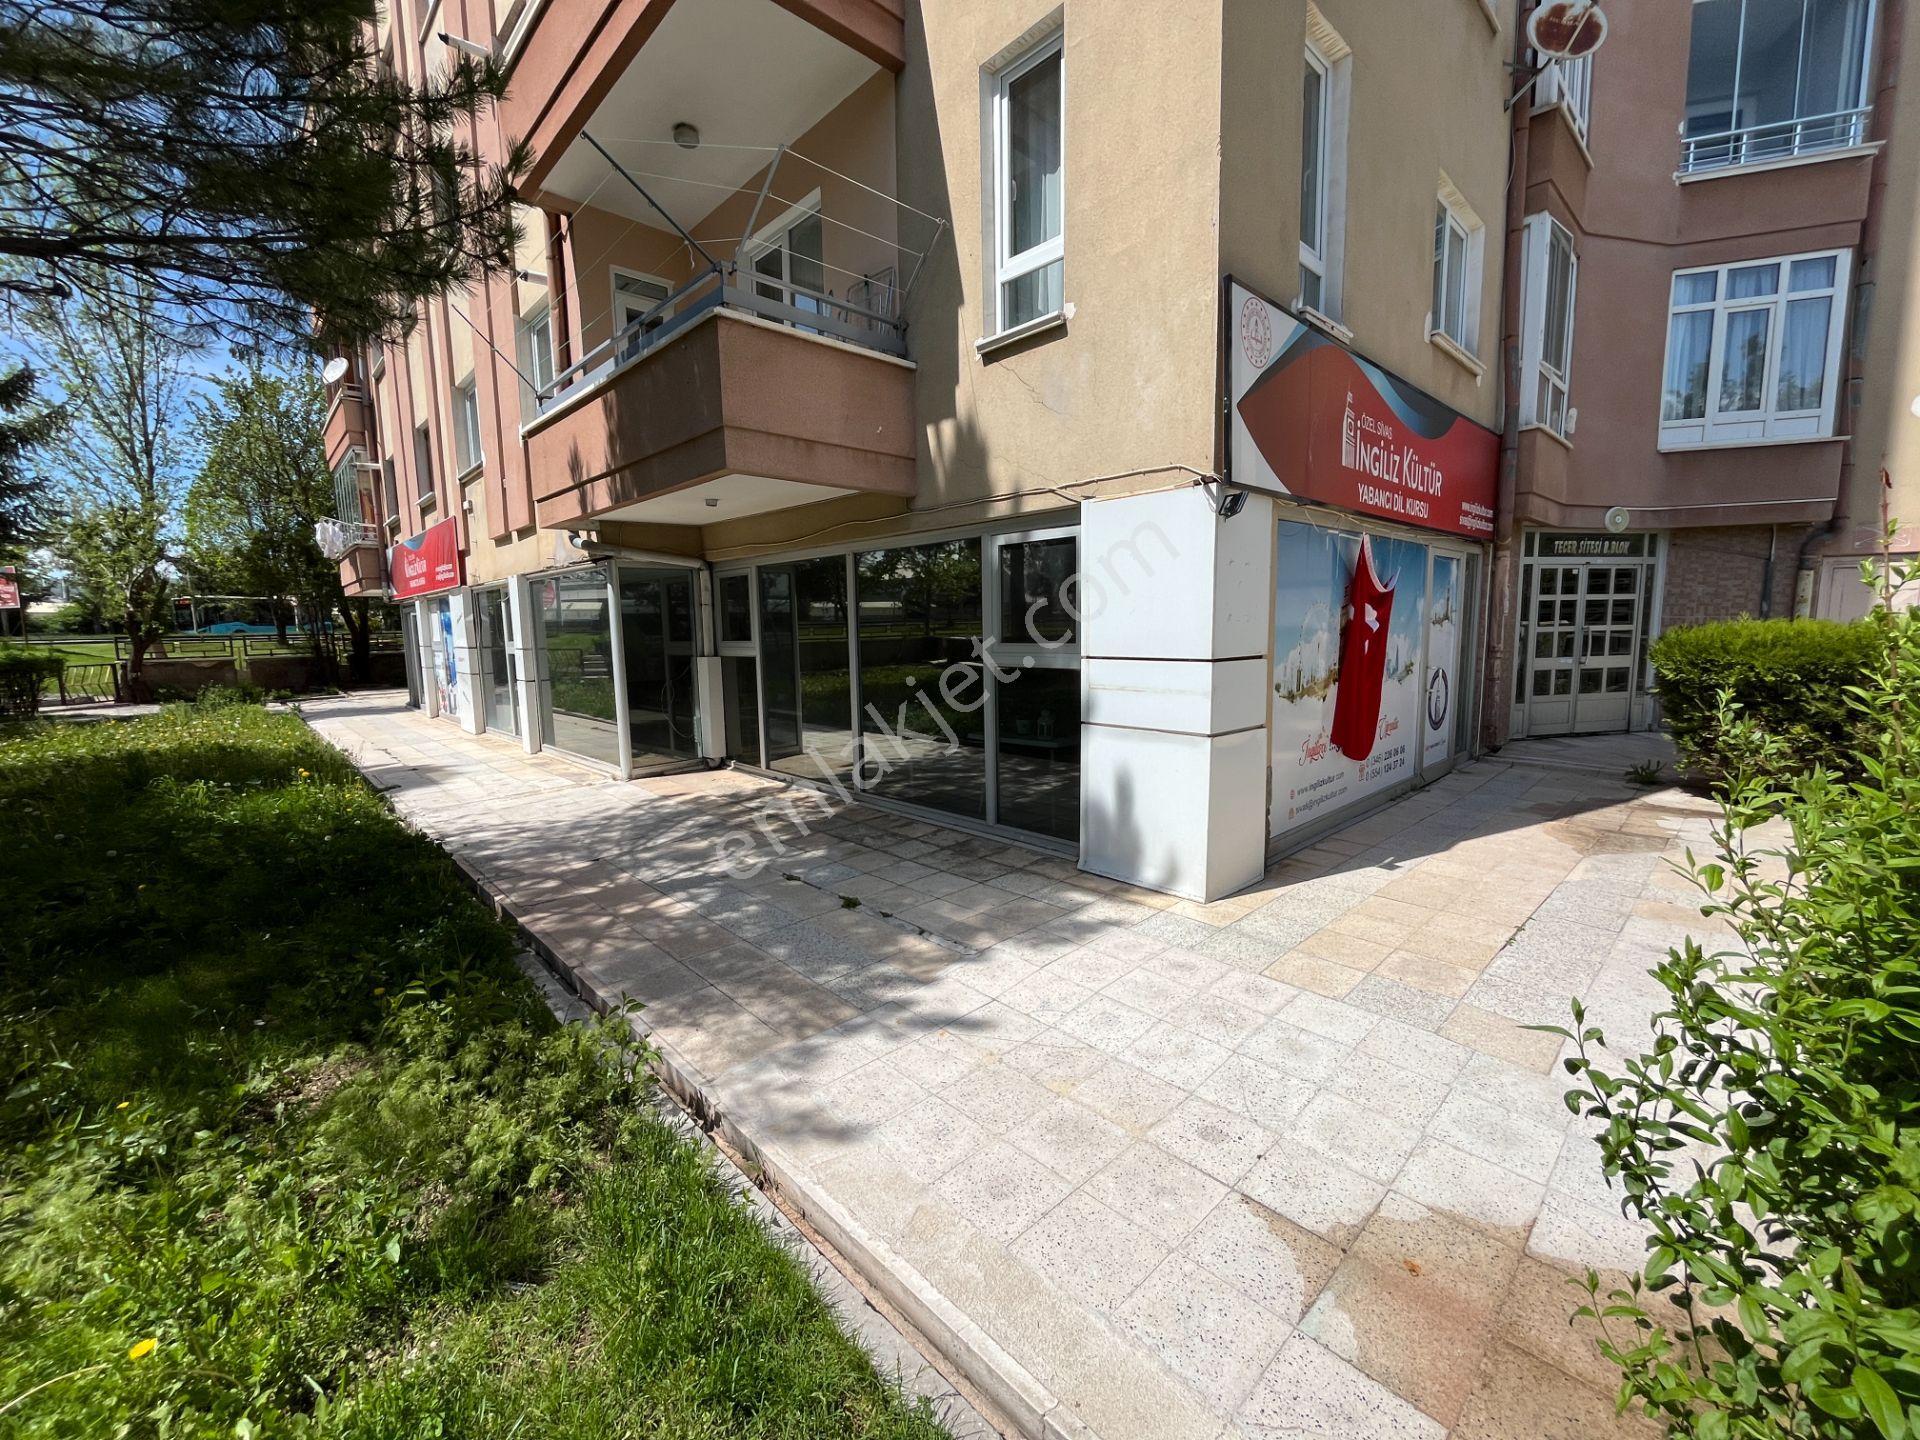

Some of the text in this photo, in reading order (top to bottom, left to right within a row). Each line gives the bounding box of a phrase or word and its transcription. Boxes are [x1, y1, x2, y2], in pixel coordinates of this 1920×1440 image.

[1361, 412, 1393, 440] ÖZEL SİVAS
[1355, 420, 1443, 497] İNGİLİZ KÜLTÜR
[1358, 482, 1429, 519] YABANCI DİL KURSU
[1554, 540, 1577, 554] TECER
[1578, 537, 1603, 554] SİTESİ
